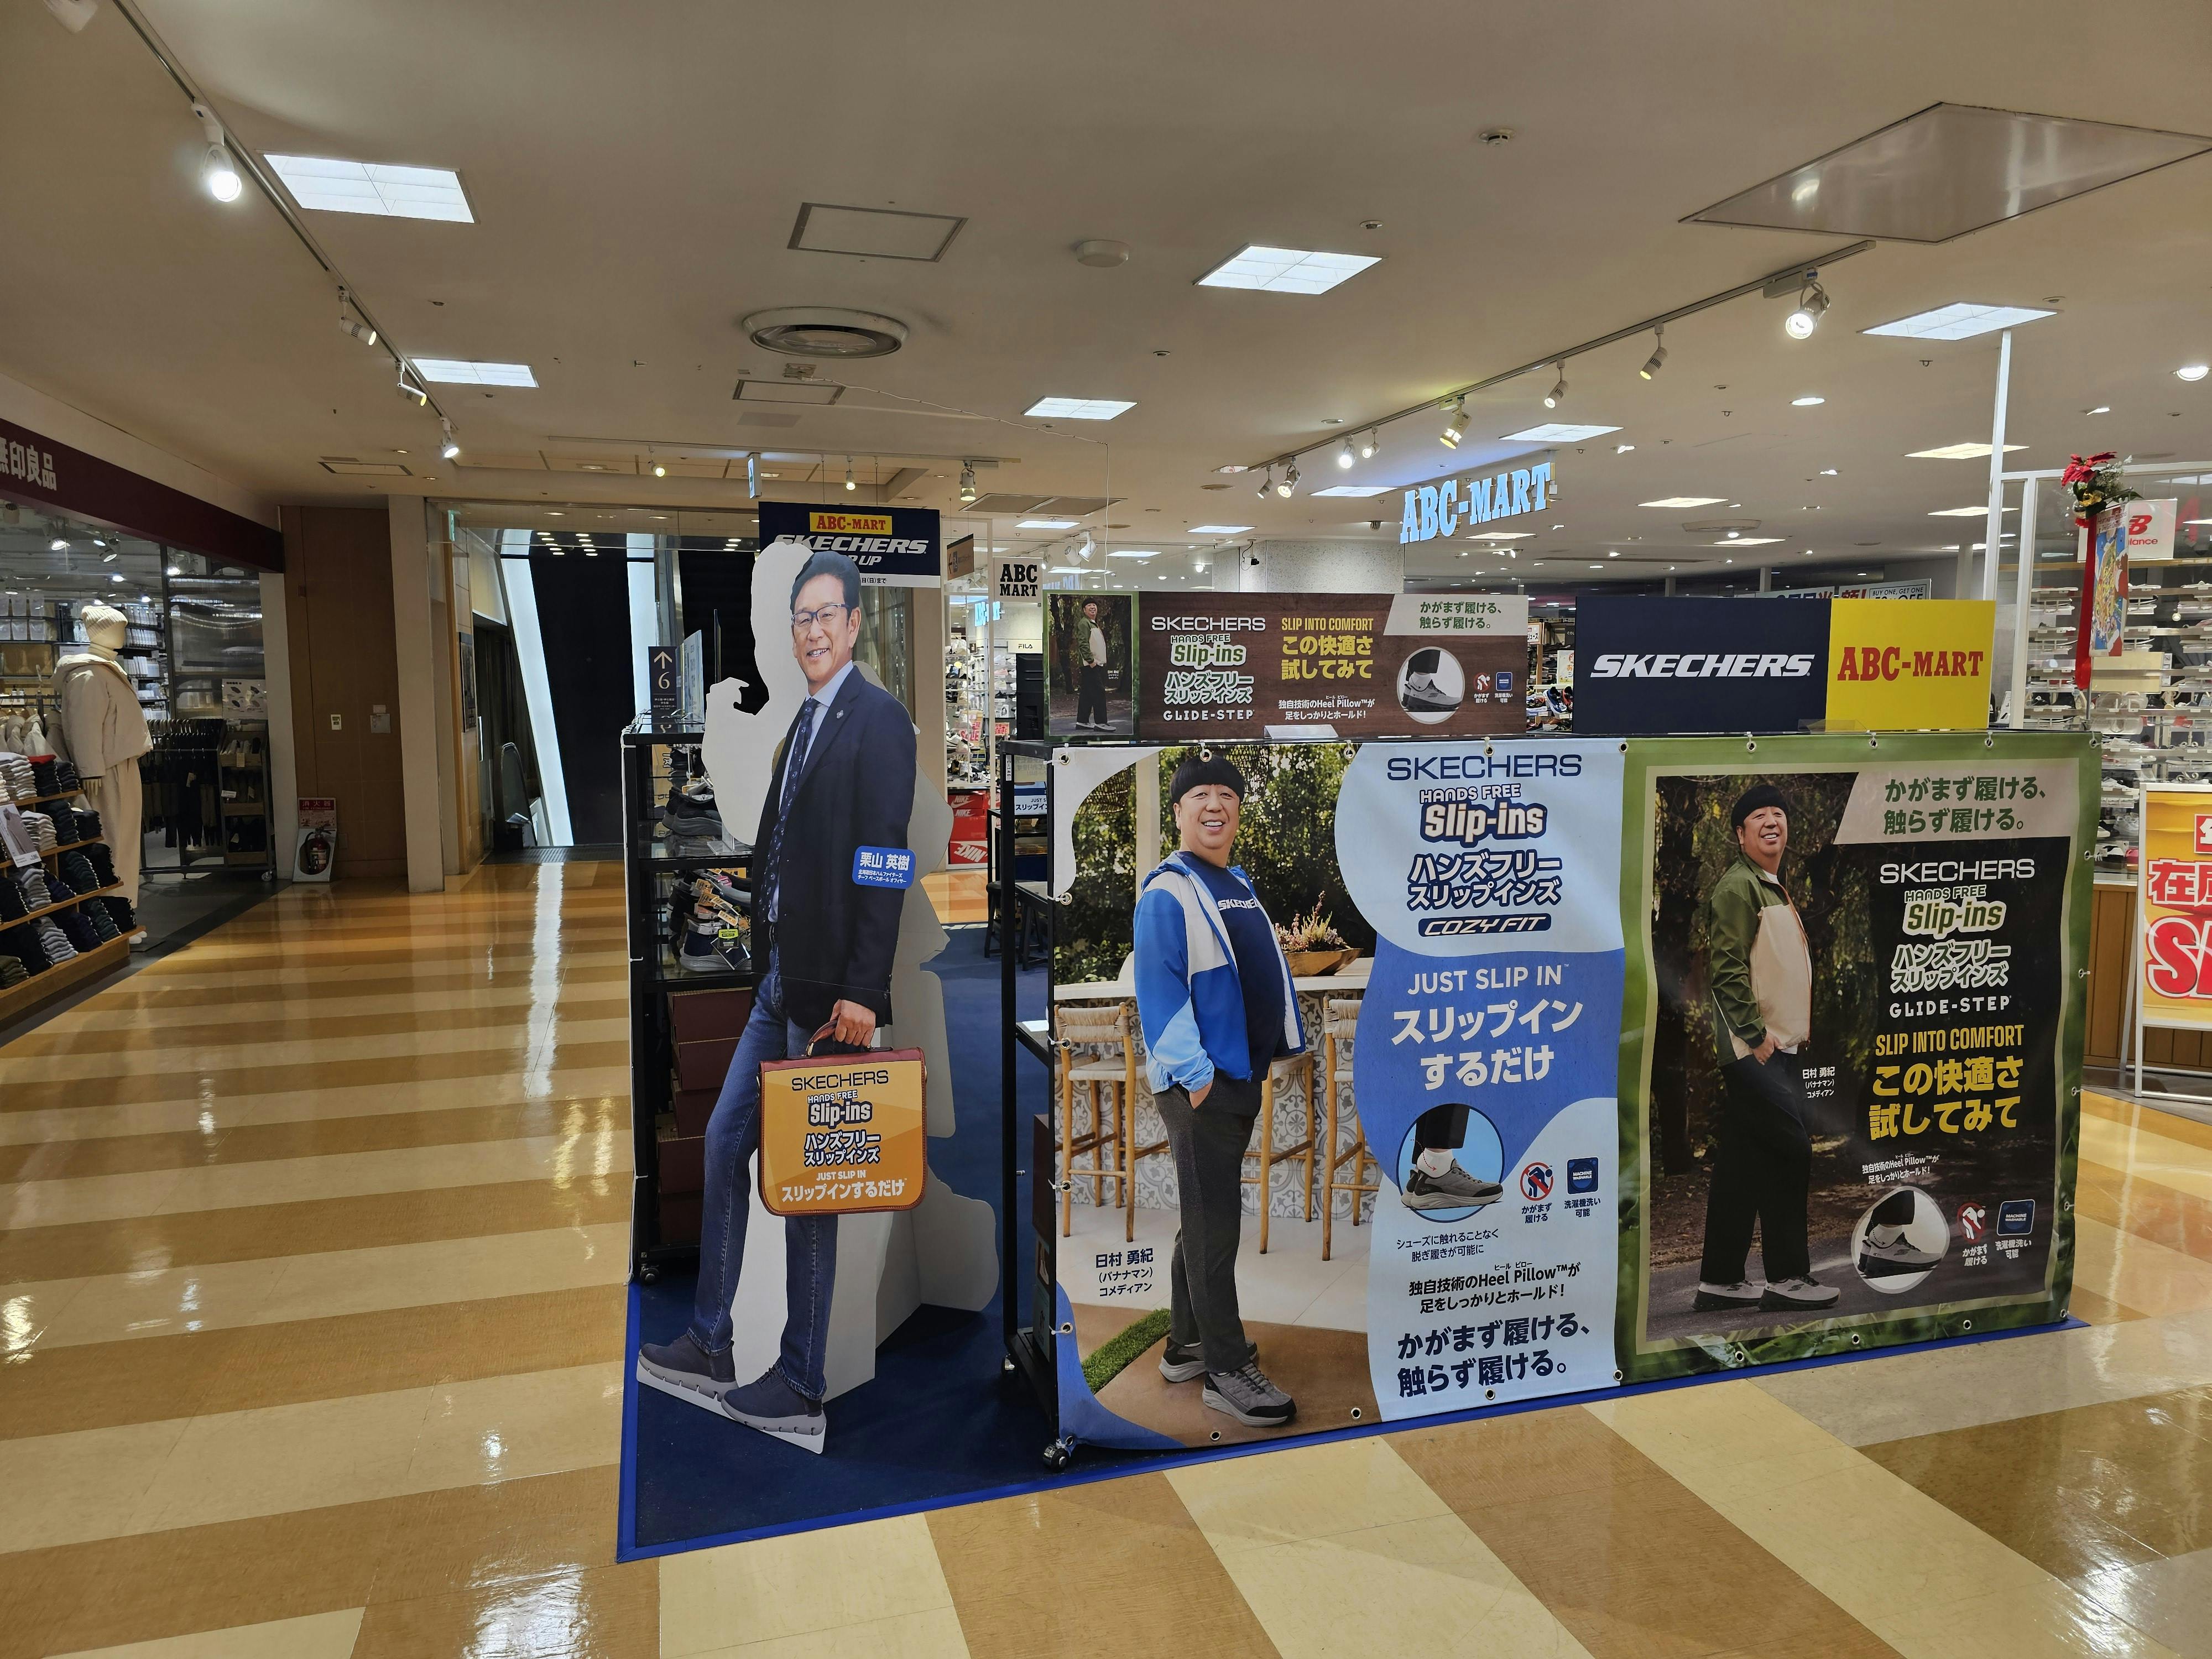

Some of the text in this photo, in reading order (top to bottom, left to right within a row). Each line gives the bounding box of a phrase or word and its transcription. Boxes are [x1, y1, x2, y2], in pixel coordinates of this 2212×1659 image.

[1400, 462, 1551, 545] ABC-MART
[816, 515, 886, 530] ABC-MART
[1000, 564, 1038, 583] ABC
[999, 583, 1038, 597] MART
[1420, 601, 1503, 614] かがまず履ける、
[1151, 617, 1266, 631] SKECHERS
[1281, 618, 1374, 631] SLIP INTO COMFORT
[1419, 616, 1491, 629] 触らず履ける。
[1171, 634, 1230, 644] HANDS FREE
[1282, 635, 1374, 656] この快適さ
[1173, 643, 1245, 667] Slip-ins
[1837, 646, 1984, 681] ABC-MART
[1281, 659, 1374, 680] 試してみて
[1590, 654, 1815, 678] SKECHERS
[658, 671, 670, 689] 6
[1166, 671, 1253, 688] ハンズフリー
[1165, 688, 1252, 703] スリップインズ
[1163, 709, 1254, 721] GLIDE-STEP
[1386, 754, 1582, 781] SKECHERS
[954, 795, 970, 803] NIKE
[1420, 783, 1521, 804] HANDS FREE
[1884, 776, 2046, 803] かがまず履ける、
[955, 809, 972, 817] NIKE
[1424, 801, 1545, 844] Slip-ins
[1884, 807, 2024, 835] 触らず履ける。
[859, 852, 910, 871] 栗山 英樹
[953, 844, 988, 863] NIKE
[1410, 851, 1561, 884] ハンズフリー
[1880, 858, 2035, 884] SKECHERS
[1408, 880, 1561, 909] スリップインズ
[1905, 884, 1986, 904] HANDS FREE
[1424, 916, 1547, 936] COZY FIT
[1906, 900, 2004, 935] Slip-ins
[1893, 941, 2010, 968] ハンズフリー
[1407, 971, 1468, 995] JUST
[1475, 967, 1529, 990] SLIP
[1892, 963, 2007, 991] スリップインズ
[1889, 995, 2010, 1018] GLIDE-STEP
[1391, 998, 1584, 1046] スリップイン
[1875, 1024, 2024, 1057] SLIP INTO COMFORT
[1420, 1045, 1555, 1091] するだけ
[1802, 1066, 1835, 1079] 日村 勇紀
[1872, 1055, 2023, 1097] この快適さ
[791, 1070, 889, 1092] SKECHERS
[807, 1091, 858, 1104] HANDS FREE
[1807, 1089, 1834, 1098] コメディアン
[810, 1102, 872, 1127] Slip-ins
[1869, 1095, 2021, 1140] 試してみて
[805, 1131, 881, 1150] ハンズフリー
[804, 1147, 880, 1166] スリップインズ
[816, 1171, 837, 1181] JUST
[838, 1170, 856, 1180] SLIP
[781, 1179, 905, 1203] スリップインするだけ
[1521, 1202, 1552, 1214] かがまず
[1564, 1197, 1601, 1209] 洗濯機洗い
[1575, 1208, 1590, 1218] 可能
[1525, 1213, 1548, 1224] 履ける
[1396, 1228, 1499, 1250] シューズに触れることなく
[1095, 1248, 1154, 1269] 日村 勇紀
[1411, 1244, 1484, 1262] 脱ぎ履きが可能に
[1962, 1244, 1987, 1257] かがまず
[1494, 1263, 1511, 1271] ヒール
[1099, 1282, 1152, 1297] コメディアン
[1408, 1270, 1510, 1297] 独自技術のHeel
[1397, 1312, 1590, 1360] かがまず履ける、
[1397, 1349, 1567, 1398] 触らず履ける。
